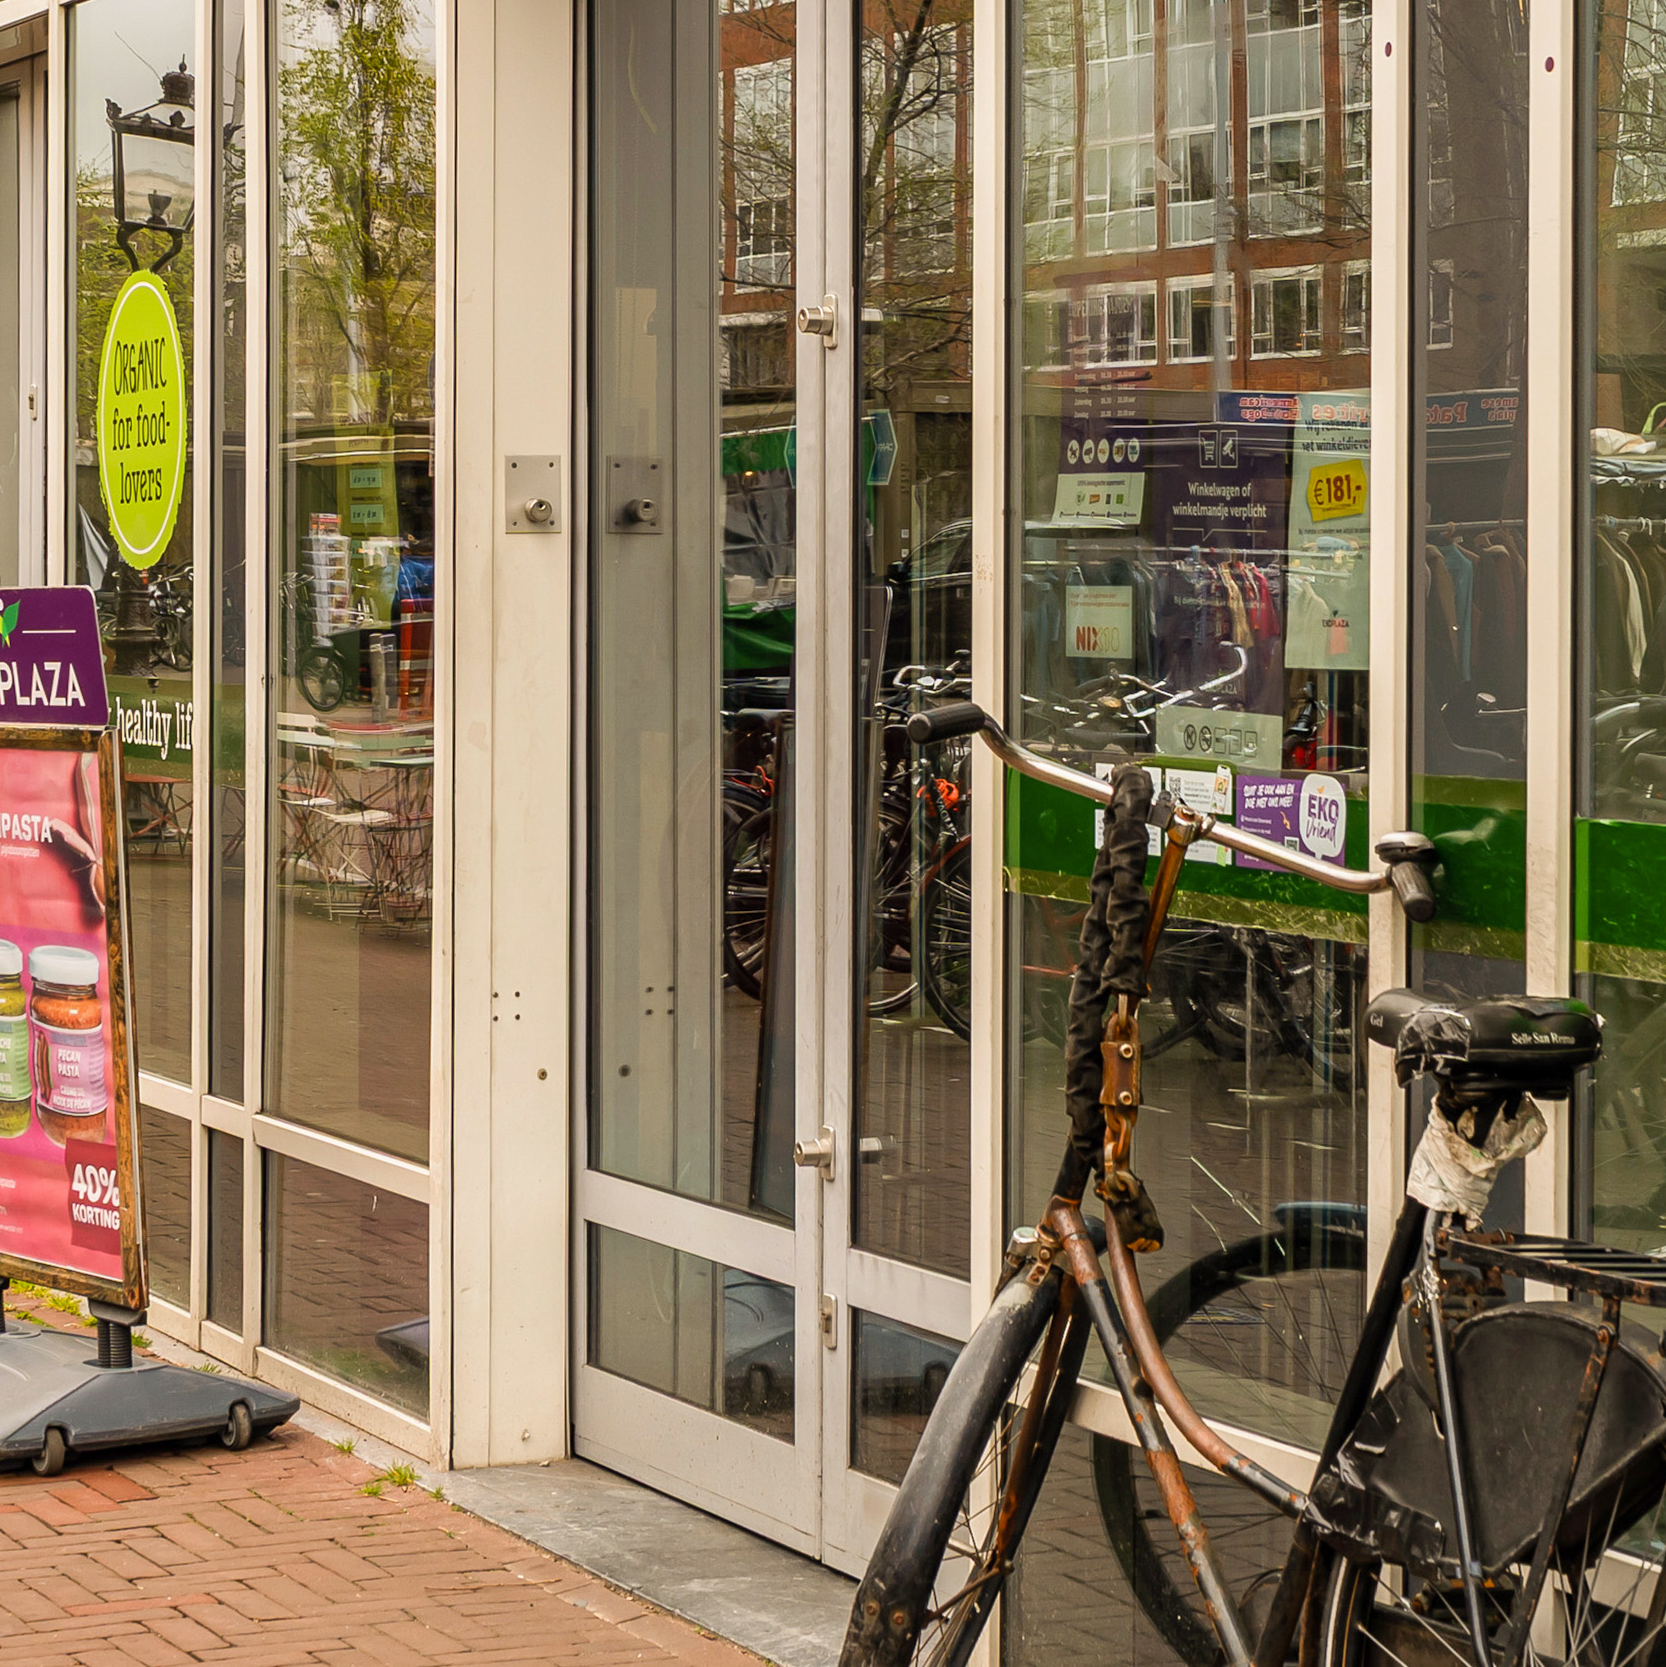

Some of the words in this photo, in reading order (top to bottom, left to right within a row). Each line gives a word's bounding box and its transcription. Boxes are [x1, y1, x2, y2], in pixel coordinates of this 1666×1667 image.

[114, 337, 167, 396] ORGANIC
[112, 407, 132, 451] for
[136, 401, 170, 448] food-
[120, 462, 162, 504] lovers
[1187, 482, 1240, 501] Winkelwagen
[1241, 483, 1252, 497] of
[1313, 474, 1362, 505] €181,-
[1172, 501, 1229, 521] winkelmandje
[1230, 503, 1267, 521] verplicht
[115, 697, 172, 761] healthy
[1308, 794, 1339, 824] EKO
[1306, 816, 1338, 849] Vriend
[1370, 1013, 1383, 1028] Gel
[1511, 1032, 1533, 1045] Selle
[1533, 1032, 1551, 1044] San
[1551, 1032, 1576, 1045] Remo
[57, 1048, 81, 1063] PECAN
[57, 1063, 80, 1078] PASTA
[71, 1163, 120, 1207] 40%
[71, 1202, 121, 1231] KORTING
